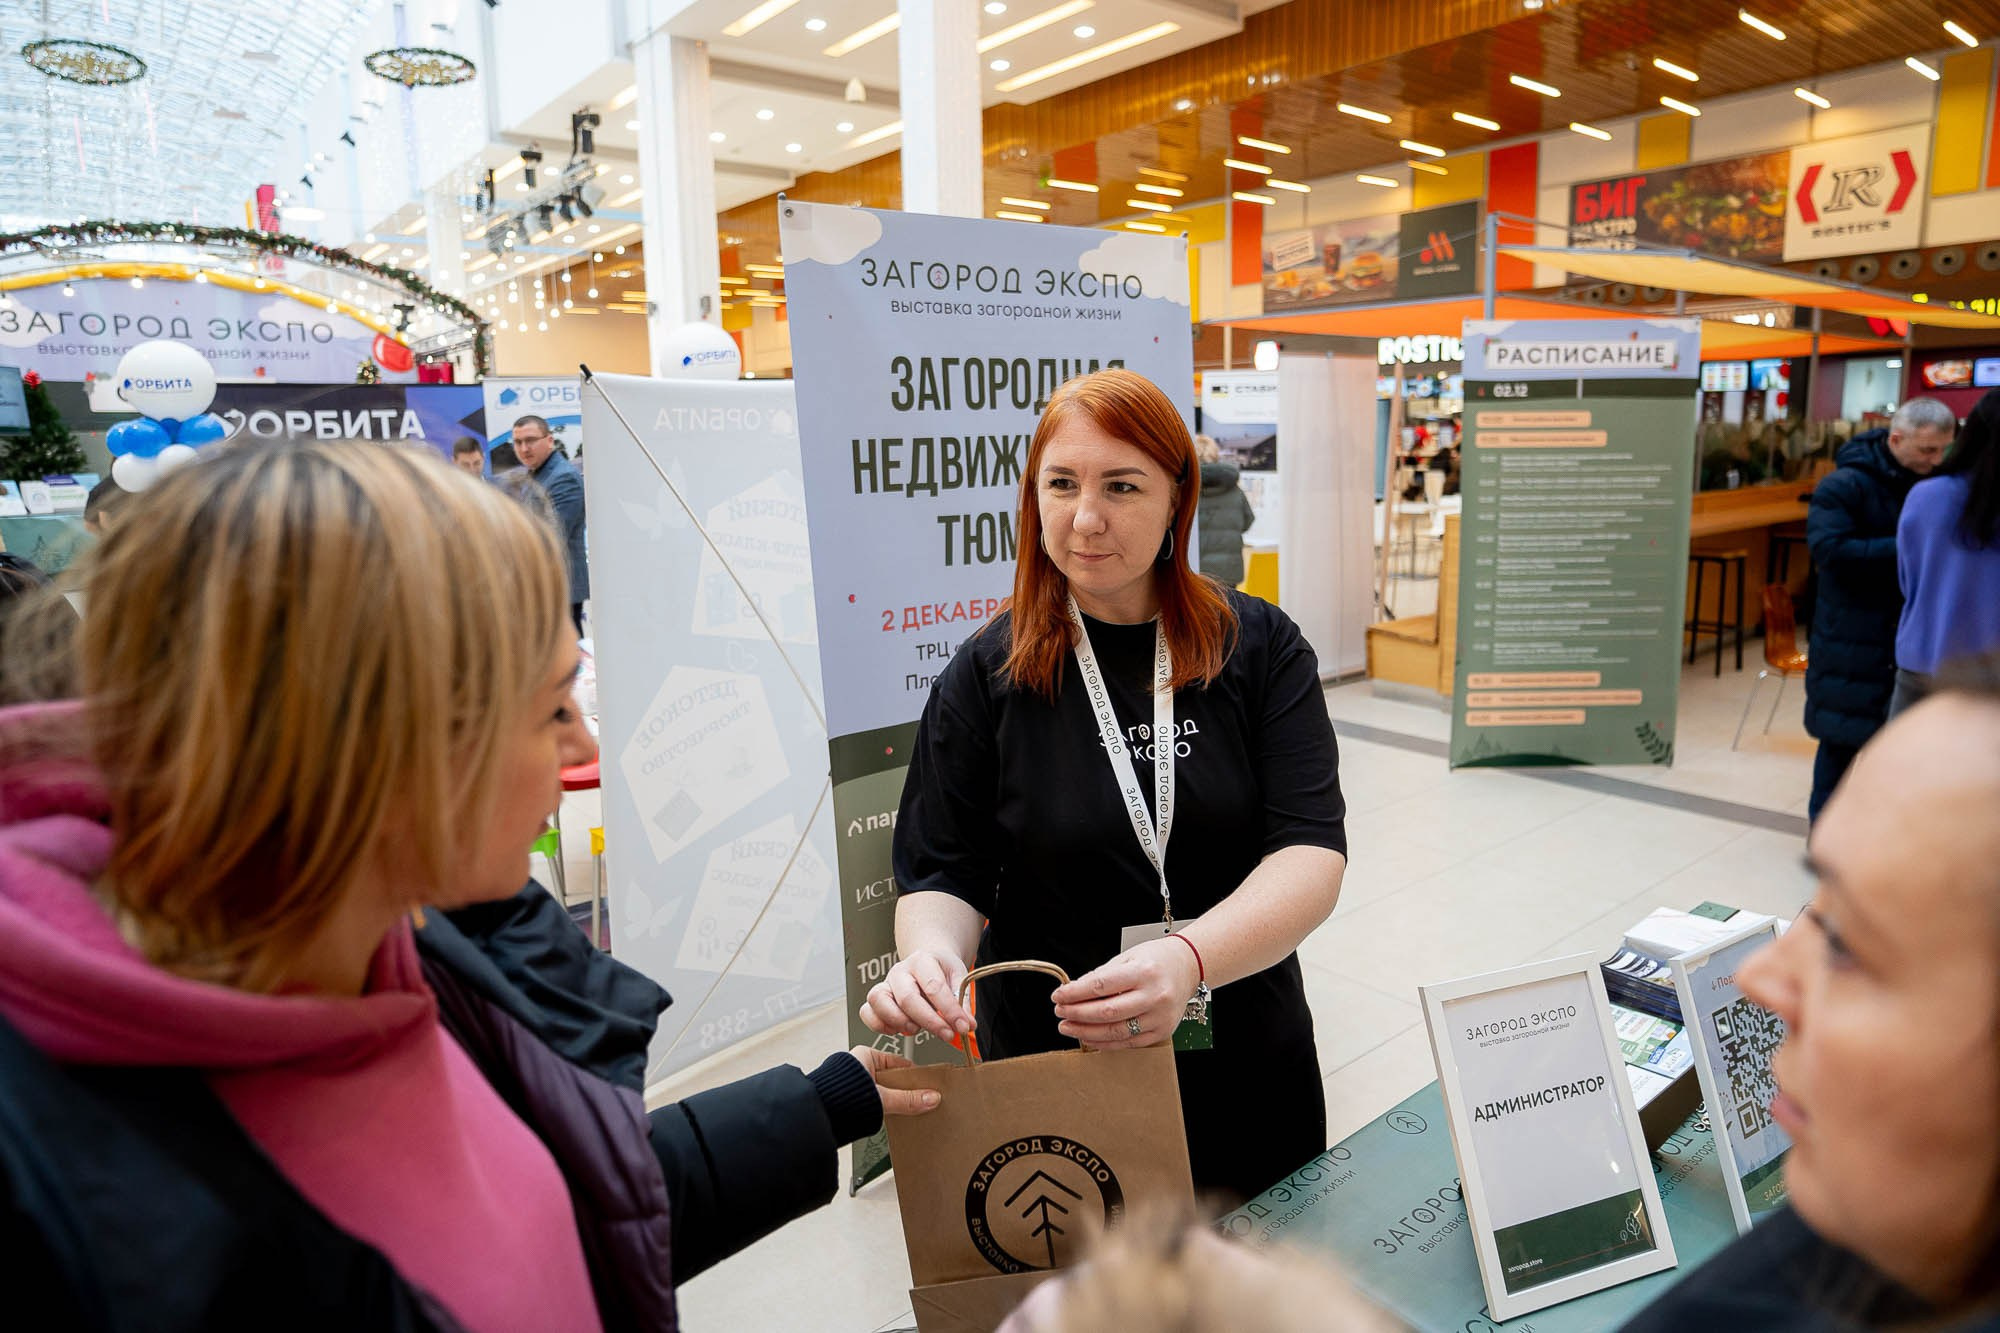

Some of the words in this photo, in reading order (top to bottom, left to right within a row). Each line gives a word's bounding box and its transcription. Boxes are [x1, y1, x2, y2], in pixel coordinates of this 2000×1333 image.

[1575, 176, 1647, 224] БИГ
[860, 257, 1023, 295] ЗАГОРОД
[1035, 269, 1143, 300] ЭКСПО
[0, 310, 193, 340] ЗАГОРОД
[208, 318, 334, 344] ЭКСПО
[891, 299, 972, 316] выставка
[977, 303, 1072, 321] загородной
[1075, 307, 1122, 321] жизни
[1497, 345, 1666, 365] РАСПИСАНИЕ
[135, 377, 193, 389] ОРБИТА
[248, 408, 426, 440] ОРБИТА
[881, 609, 895, 632] 2
[902, 596, 1012, 633] ДЕКАБР
[916, 641, 950, 661] ТРЦ
[1081, 655, 1106, 709] ЗАГОРОД
[1100, 711, 1122, 755] ЭКСПО
[1159, 726, 1169, 770] ЭКСПО
[1126, 787, 1152, 847] ЗАГОРОД
[1159, 775, 1170, 836] ЗАГОРОД
[1465, 1016, 1528, 1040] ЗАГОРОД
[1530, 1005, 1577, 1025] ЭКСПО
[1474, 1076, 1605, 1122] АДМИНИСТРАТОР
[973, 1138, 1044, 1193] ЗАГОРОД
[1050, 1139, 1110, 1183] ЭКСПО
[1269, 1147, 1352, 1202] ЭКСПО
